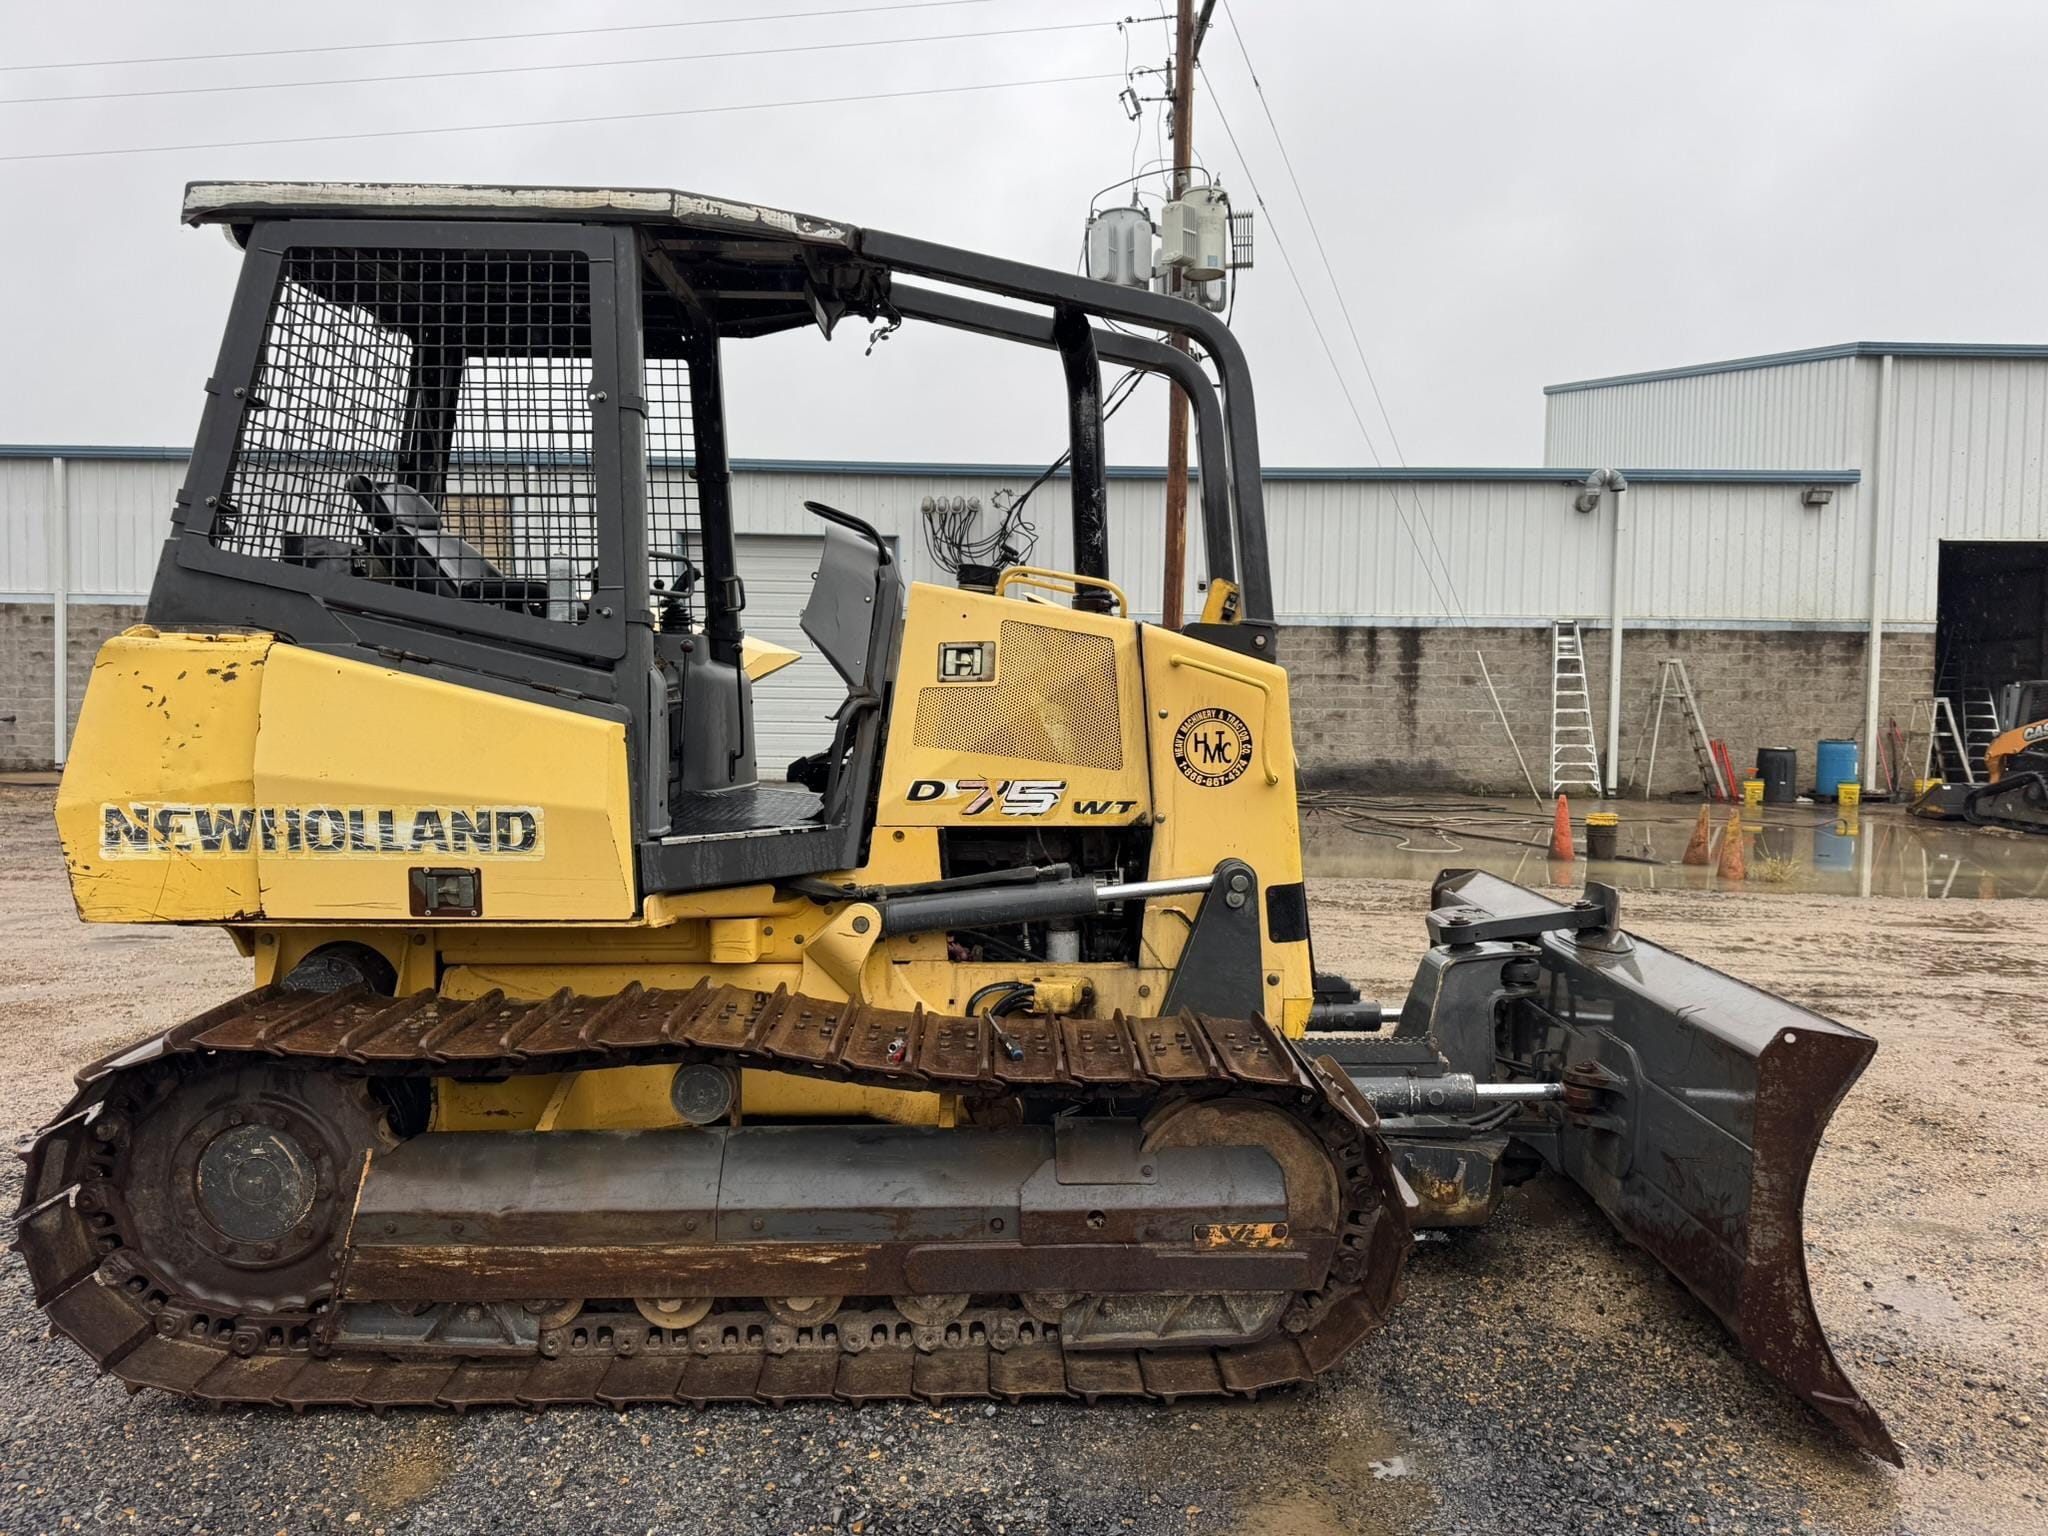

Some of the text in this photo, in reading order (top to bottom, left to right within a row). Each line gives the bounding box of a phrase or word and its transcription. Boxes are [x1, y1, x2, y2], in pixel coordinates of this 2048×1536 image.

[1174, 733, 1185, 758] HEAVY
[1180, 709, 1217, 734] MACHINERY
[1218, 710, 1224, 719] &
[1226, 713, 1250, 742] TRACTOR
[1073, 800, 1138, 815] WT
